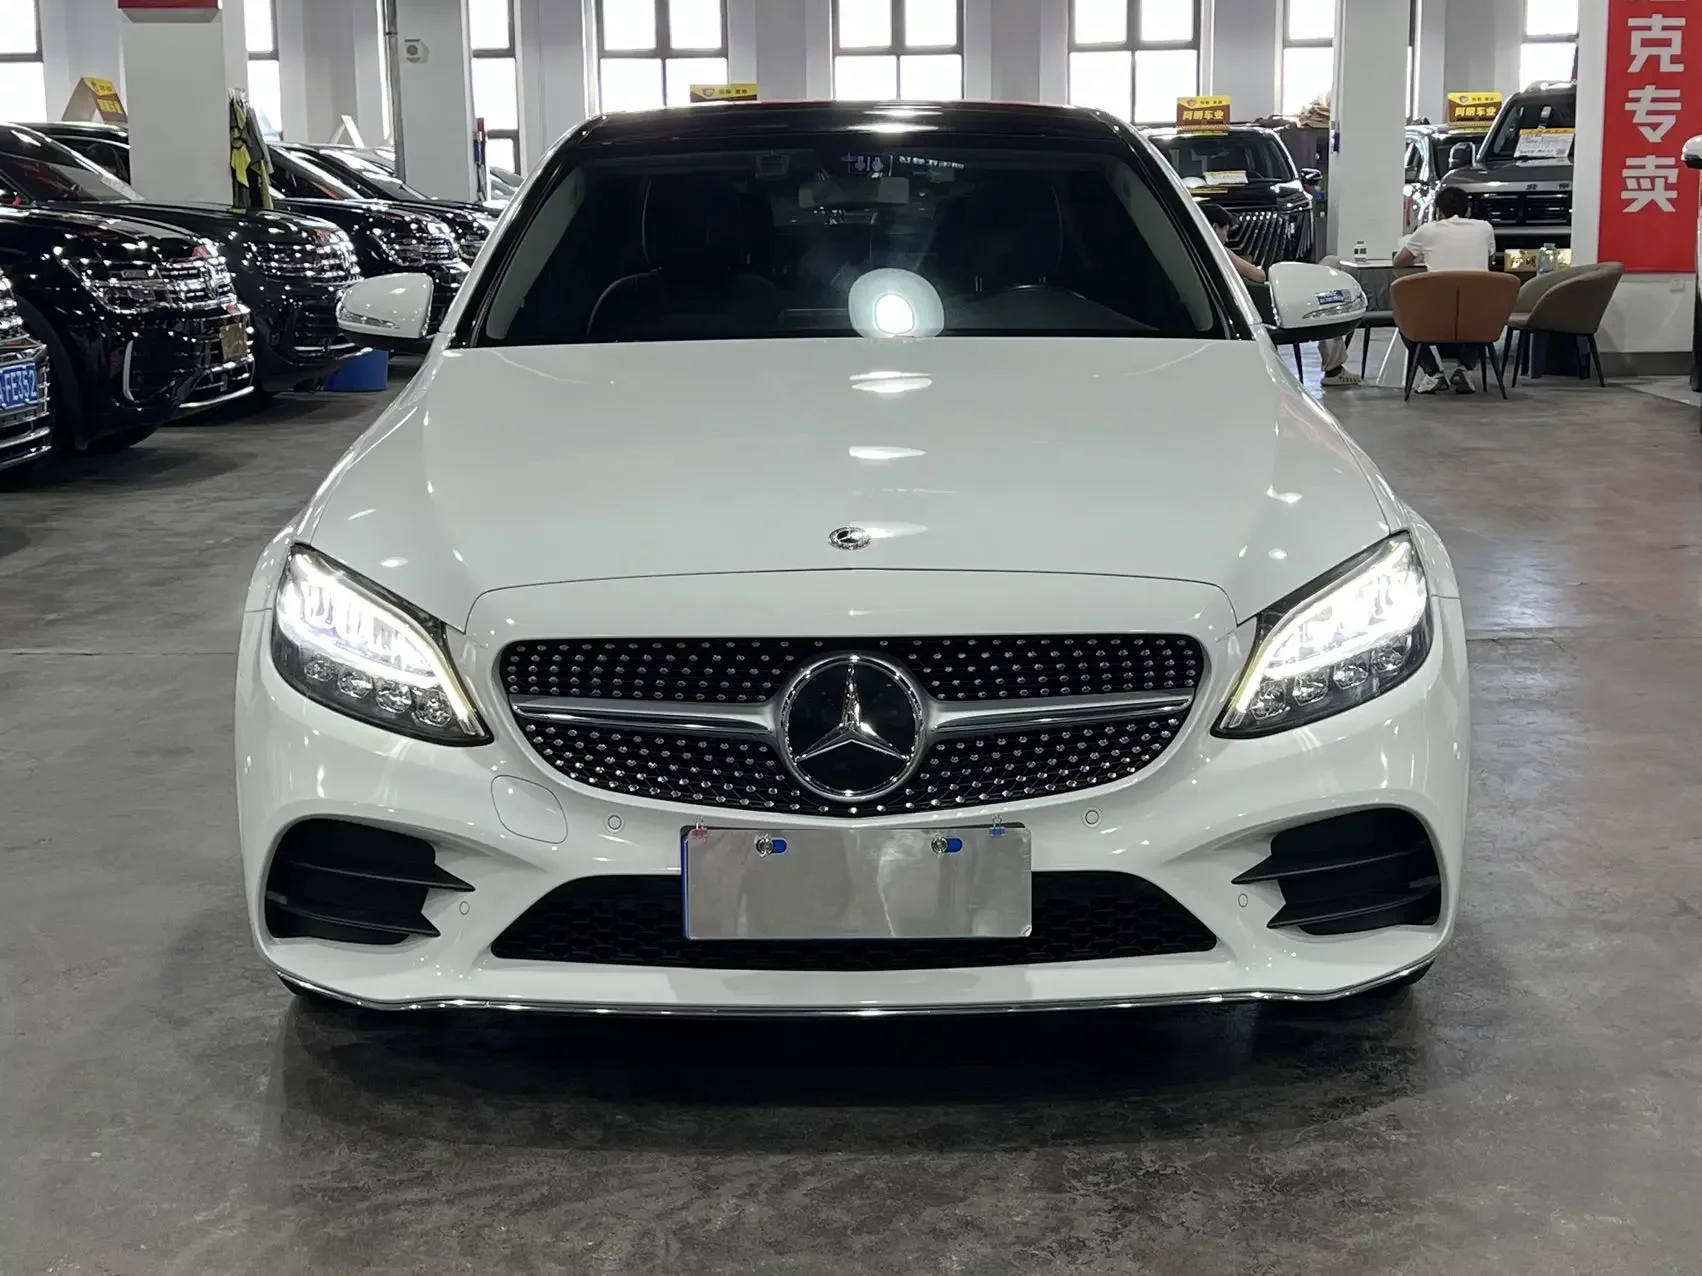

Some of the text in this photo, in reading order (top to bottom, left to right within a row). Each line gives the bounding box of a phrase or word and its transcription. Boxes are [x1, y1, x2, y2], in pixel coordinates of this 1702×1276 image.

[1621, 0, 1686, 213] 克专卖
[0, 369, 37, 402] FE352
